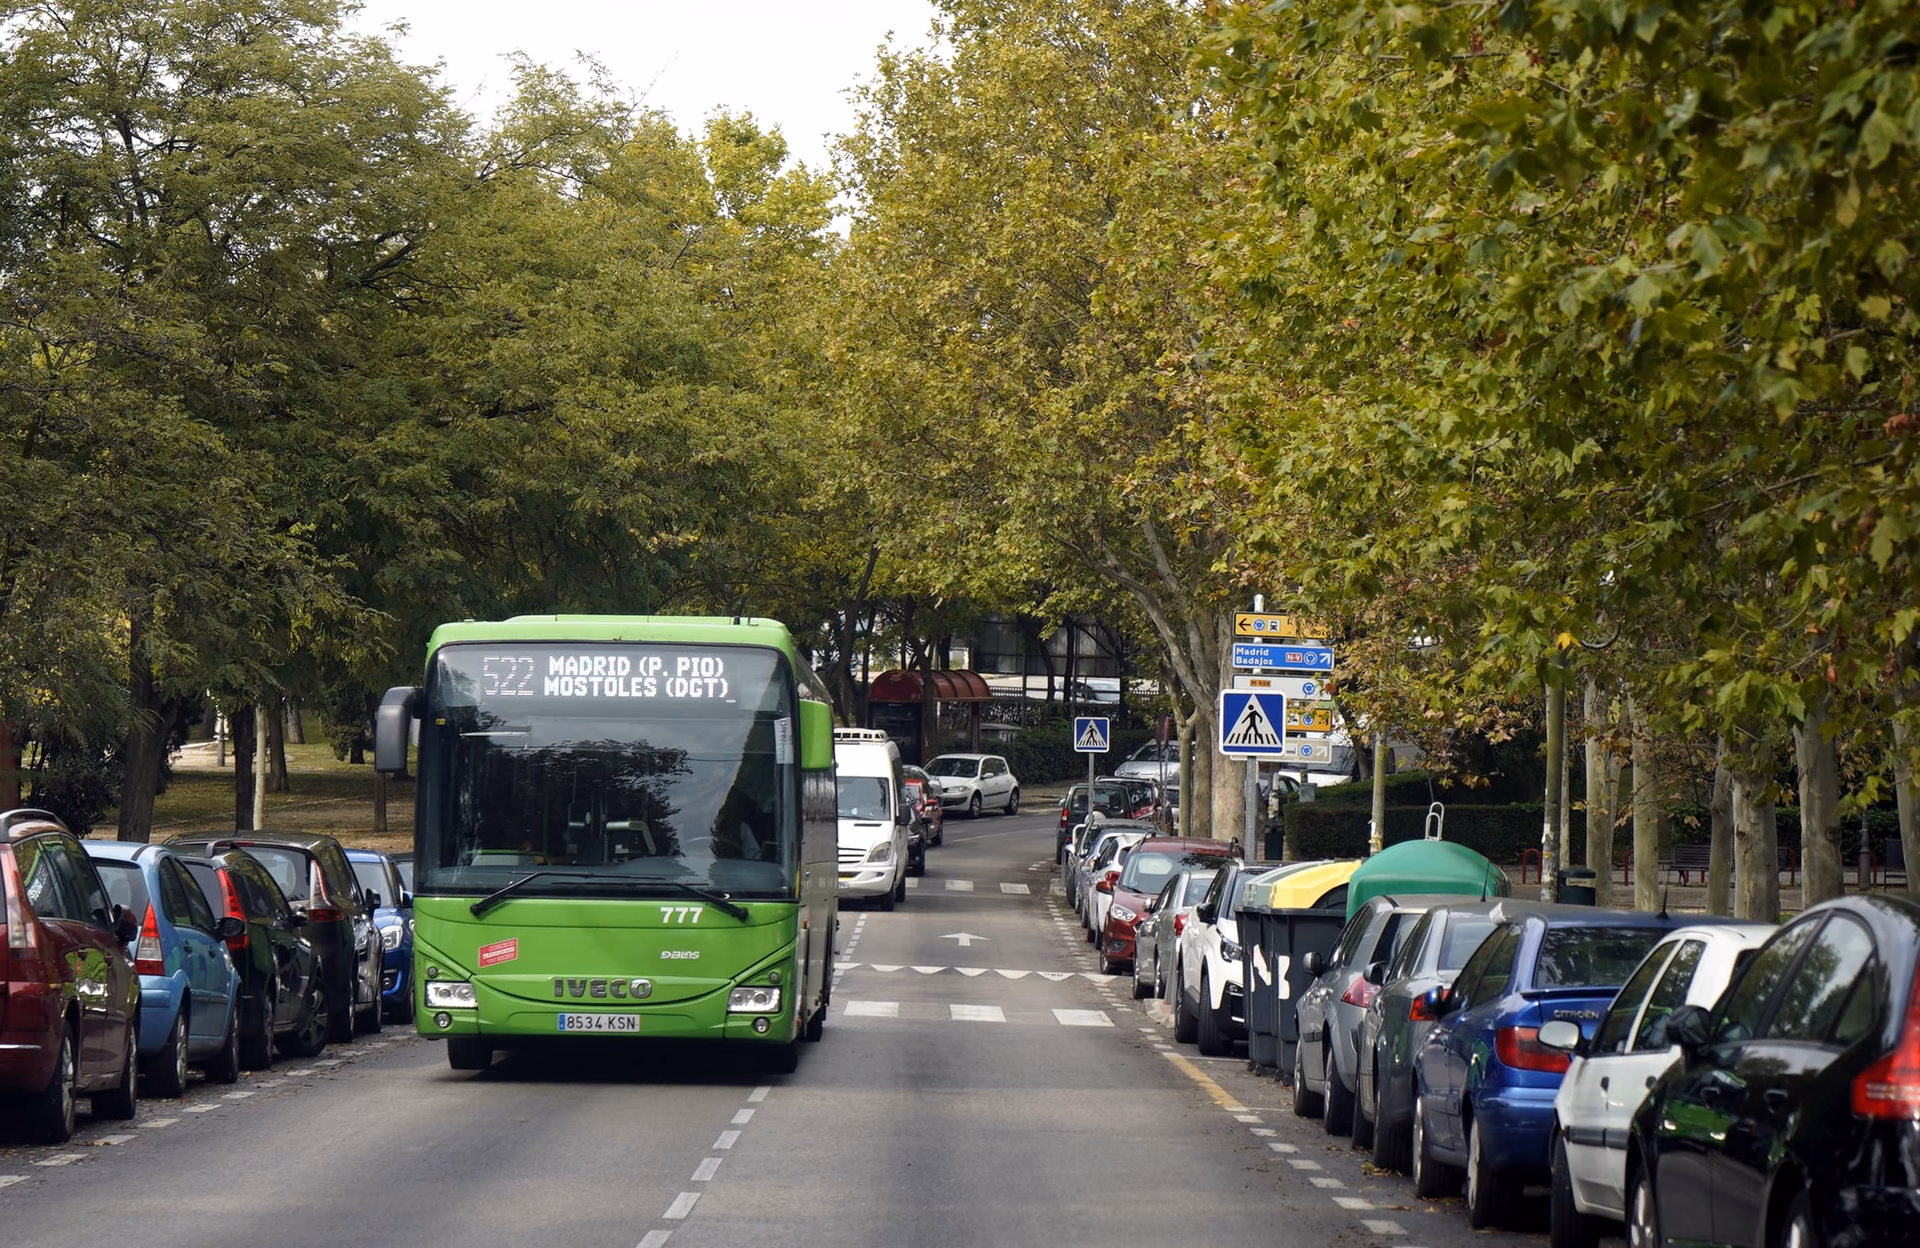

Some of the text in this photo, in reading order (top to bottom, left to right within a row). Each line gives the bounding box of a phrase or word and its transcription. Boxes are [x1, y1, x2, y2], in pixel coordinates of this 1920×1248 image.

[1236, 647, 1269, 656] Madrid
[1236, 656, 1273, 666] Badajoz
[549, 656, 630, 676] MADRID
[677, 657, 724, 677] PIO)
[483, 657, 534, 696] 522
[544, 676, 729, 698] MOSTOLES (DGT)
[660, 906, 703, 924] 777
[554, 978, 653, 999] IVECO
[567, 1015, 635, 1030] 8534 KSN
